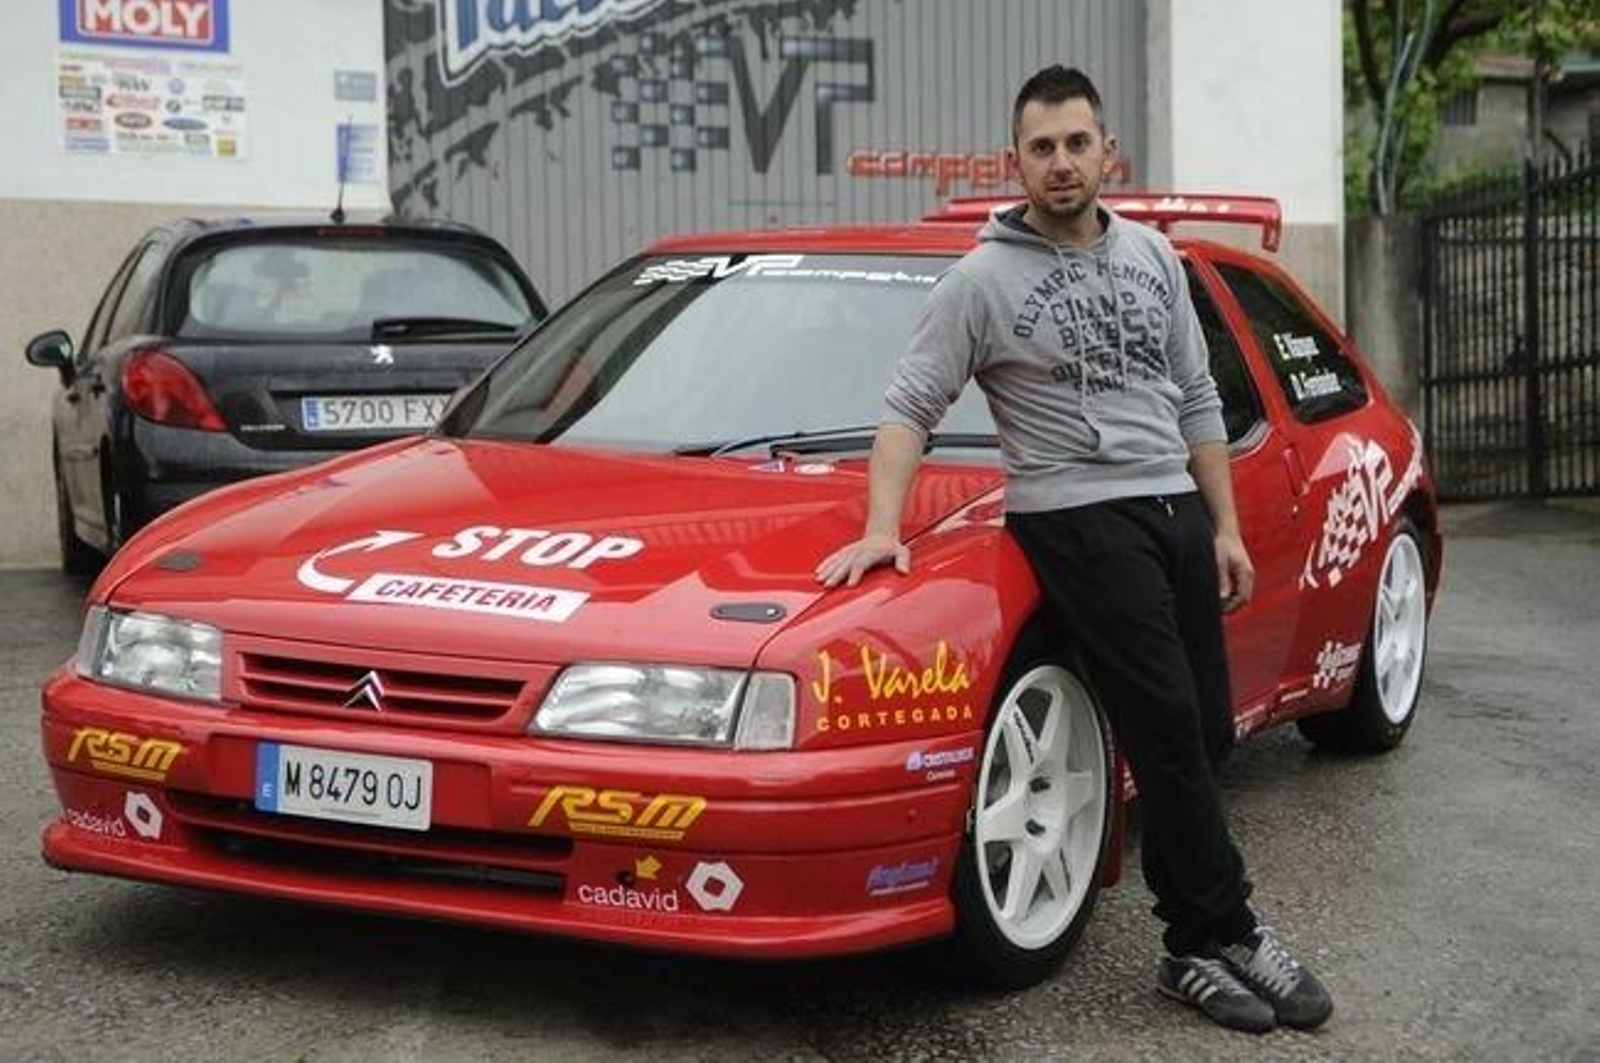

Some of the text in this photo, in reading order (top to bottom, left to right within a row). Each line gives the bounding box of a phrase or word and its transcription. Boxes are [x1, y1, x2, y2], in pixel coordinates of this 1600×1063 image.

[84, 0, 210, 37] MOLY
[1013, 261, 1087, 339] OLYMPIC
[323, 401, 394, 425] 5700
[432, 525, 645, 569] STOP
[375, 579, 557, 613] CAFETERIA
[812, 641, 970, 704] J. Varela
[816, 704, 973, 731] CORTEGADA
[67, 726, 184, 771] RSM
[284, 760, 301, 797] M
[309, 764, 379, 806] 8479
[527, 785, 708, 828] RSM
[577, 884, 679, 911] cadavid
